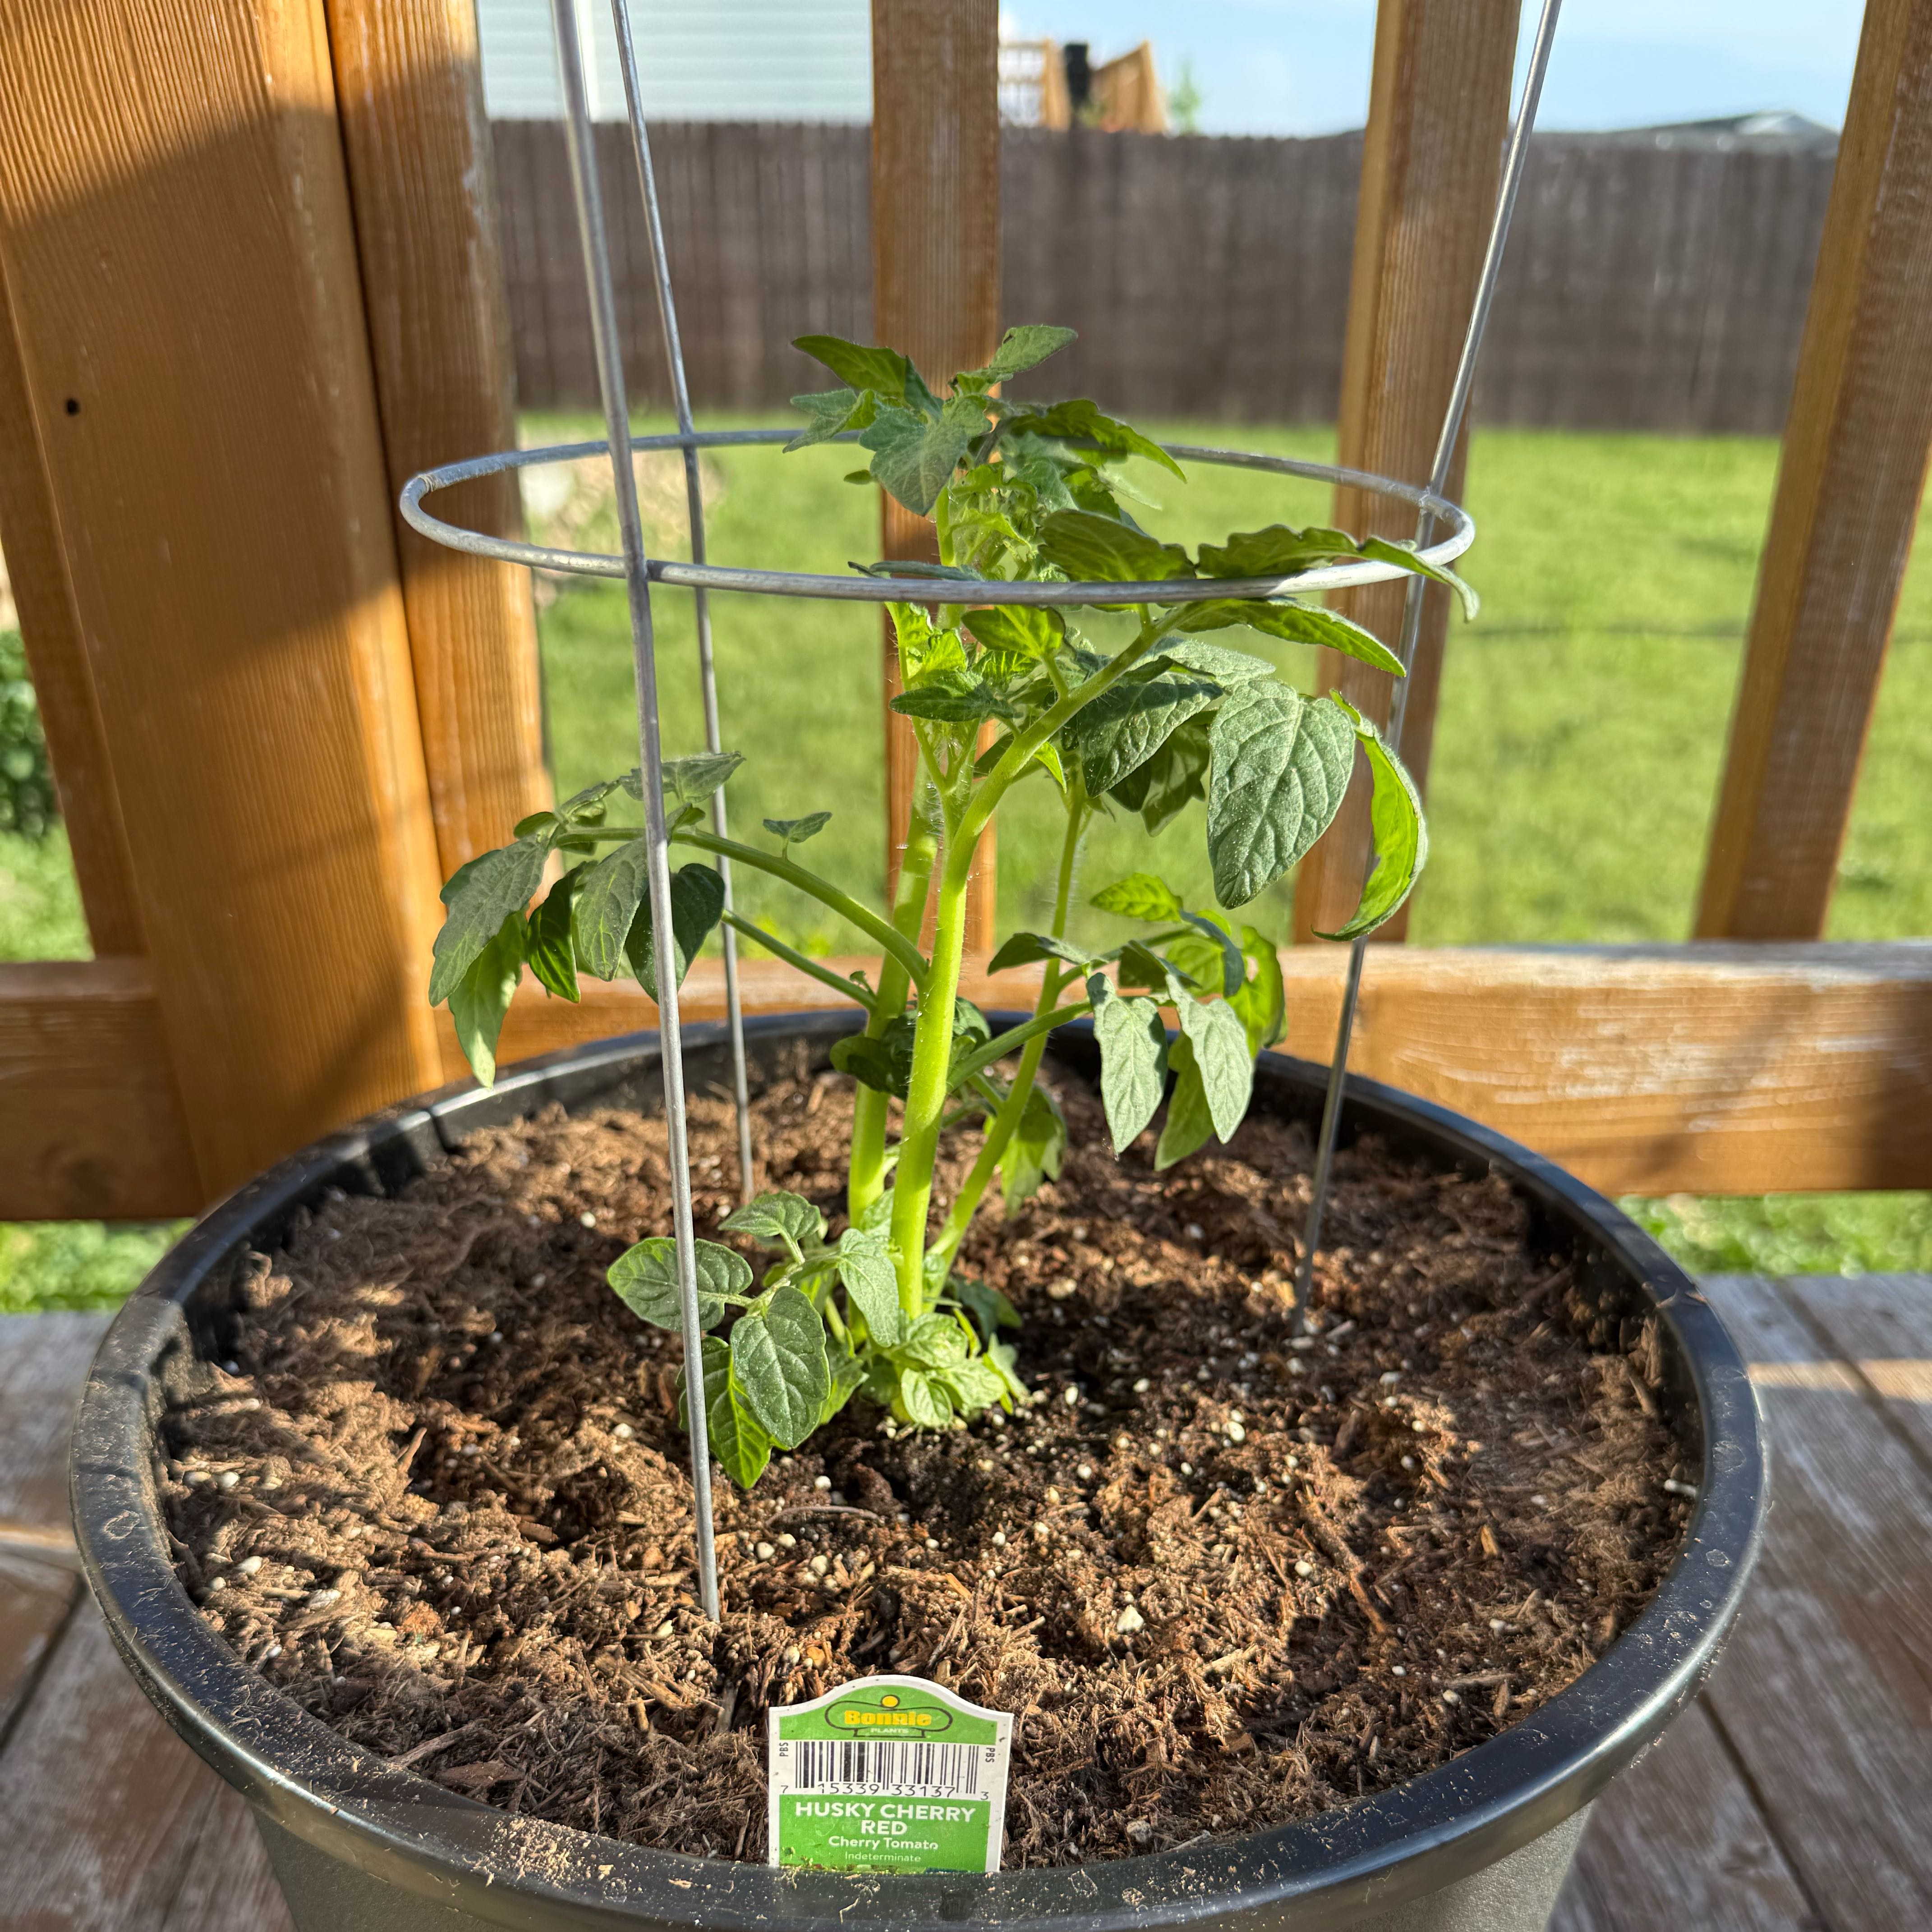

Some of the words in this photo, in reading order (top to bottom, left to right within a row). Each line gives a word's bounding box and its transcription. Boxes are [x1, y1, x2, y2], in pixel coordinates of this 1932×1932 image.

[844, 1710, 932, 1726] Bonnie
[779, 1742, 789, 1757] PBS
[985, 1748, 995, 1763] PBS
[891, 1785, 956, 1798] 33137
[796, 1802, 876, 1817] HUSKY
[880, 1804, 975, 1822] CHERRY
[861, 1821, 907, 1835] RED
[828, 1835, 880, 1850] Cherry
[883, 1838, 938, 1850] Tomato
[845, 1852, 921, 1862] Indeterminate
